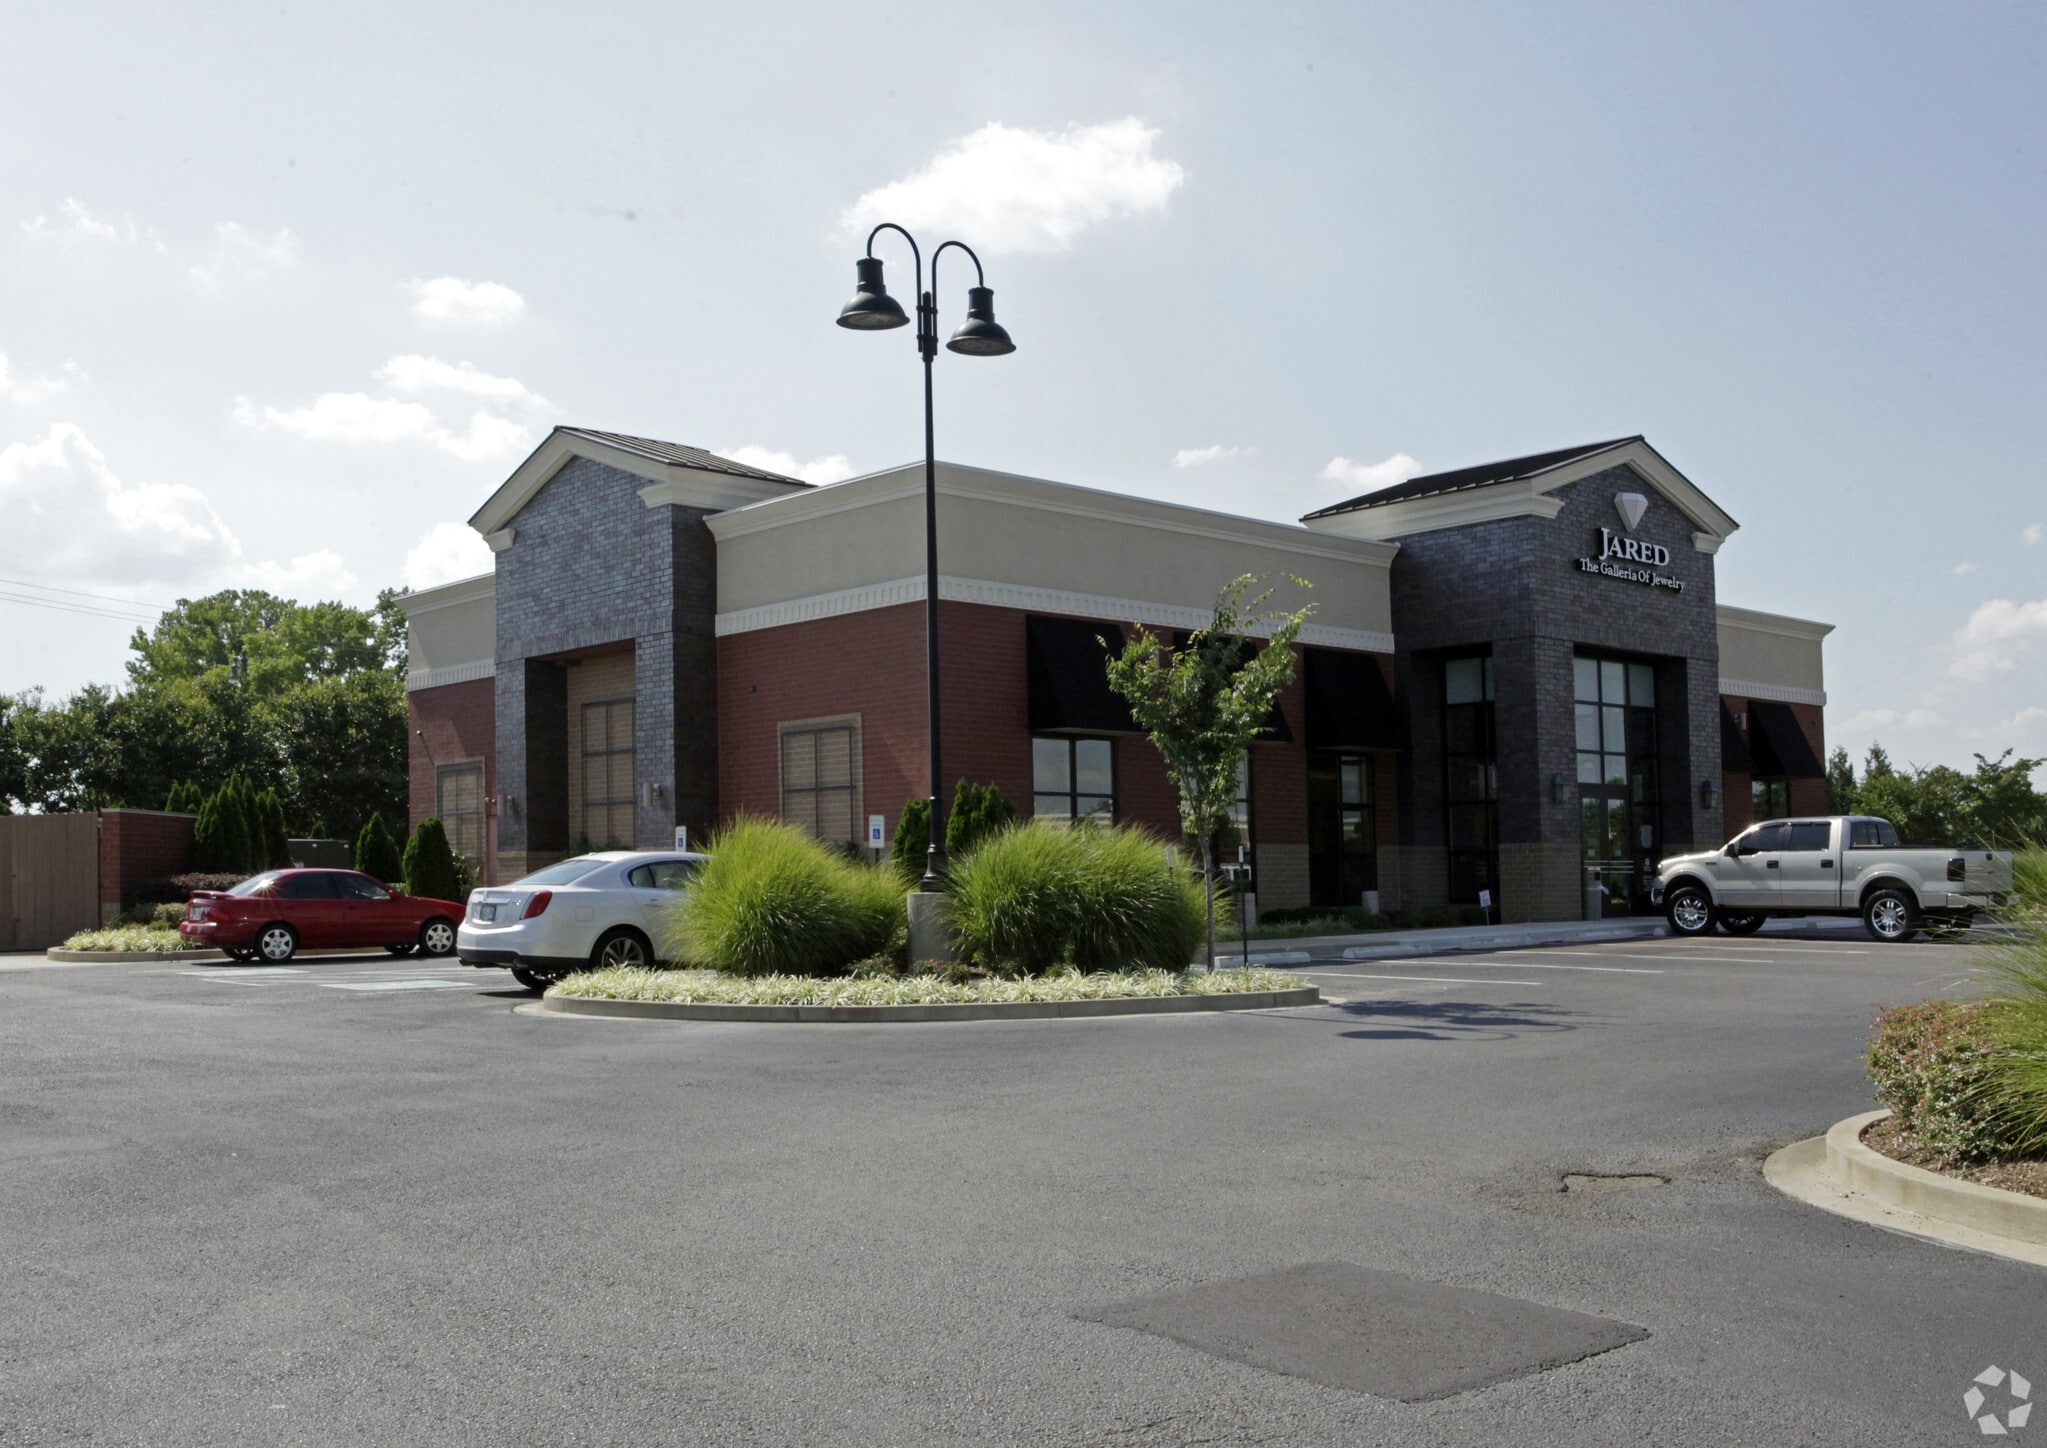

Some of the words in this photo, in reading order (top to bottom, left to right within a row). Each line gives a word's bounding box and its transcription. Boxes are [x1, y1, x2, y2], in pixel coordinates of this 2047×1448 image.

[1599, 527, 1670, 566] JARED
[1579, 558, 1599, 574] The
[1600, 561, 1637, 581] Galleria
[1638, 570, 1651, 583] Of
[1651, 572, 1686, 592] Jewelry
